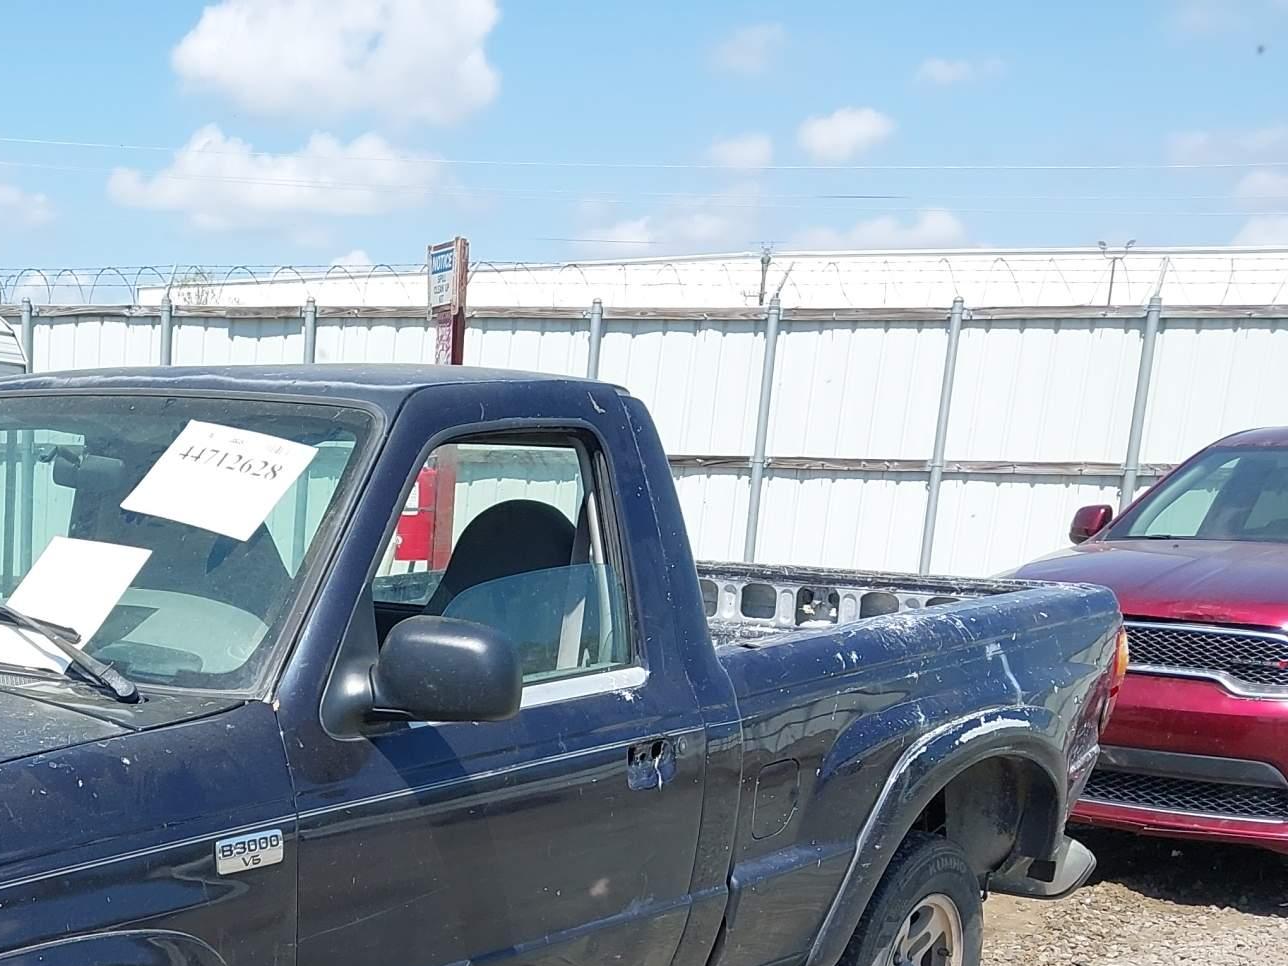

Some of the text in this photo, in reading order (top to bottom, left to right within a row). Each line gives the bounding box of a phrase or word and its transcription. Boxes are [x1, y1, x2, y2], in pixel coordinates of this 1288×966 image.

[432, 254, 452, 272] NOTICE
[179, 445, 283, 480] 44712628
[221, 834, 279, 857] B3000
[928, 856, 967, 876] KUMHO
